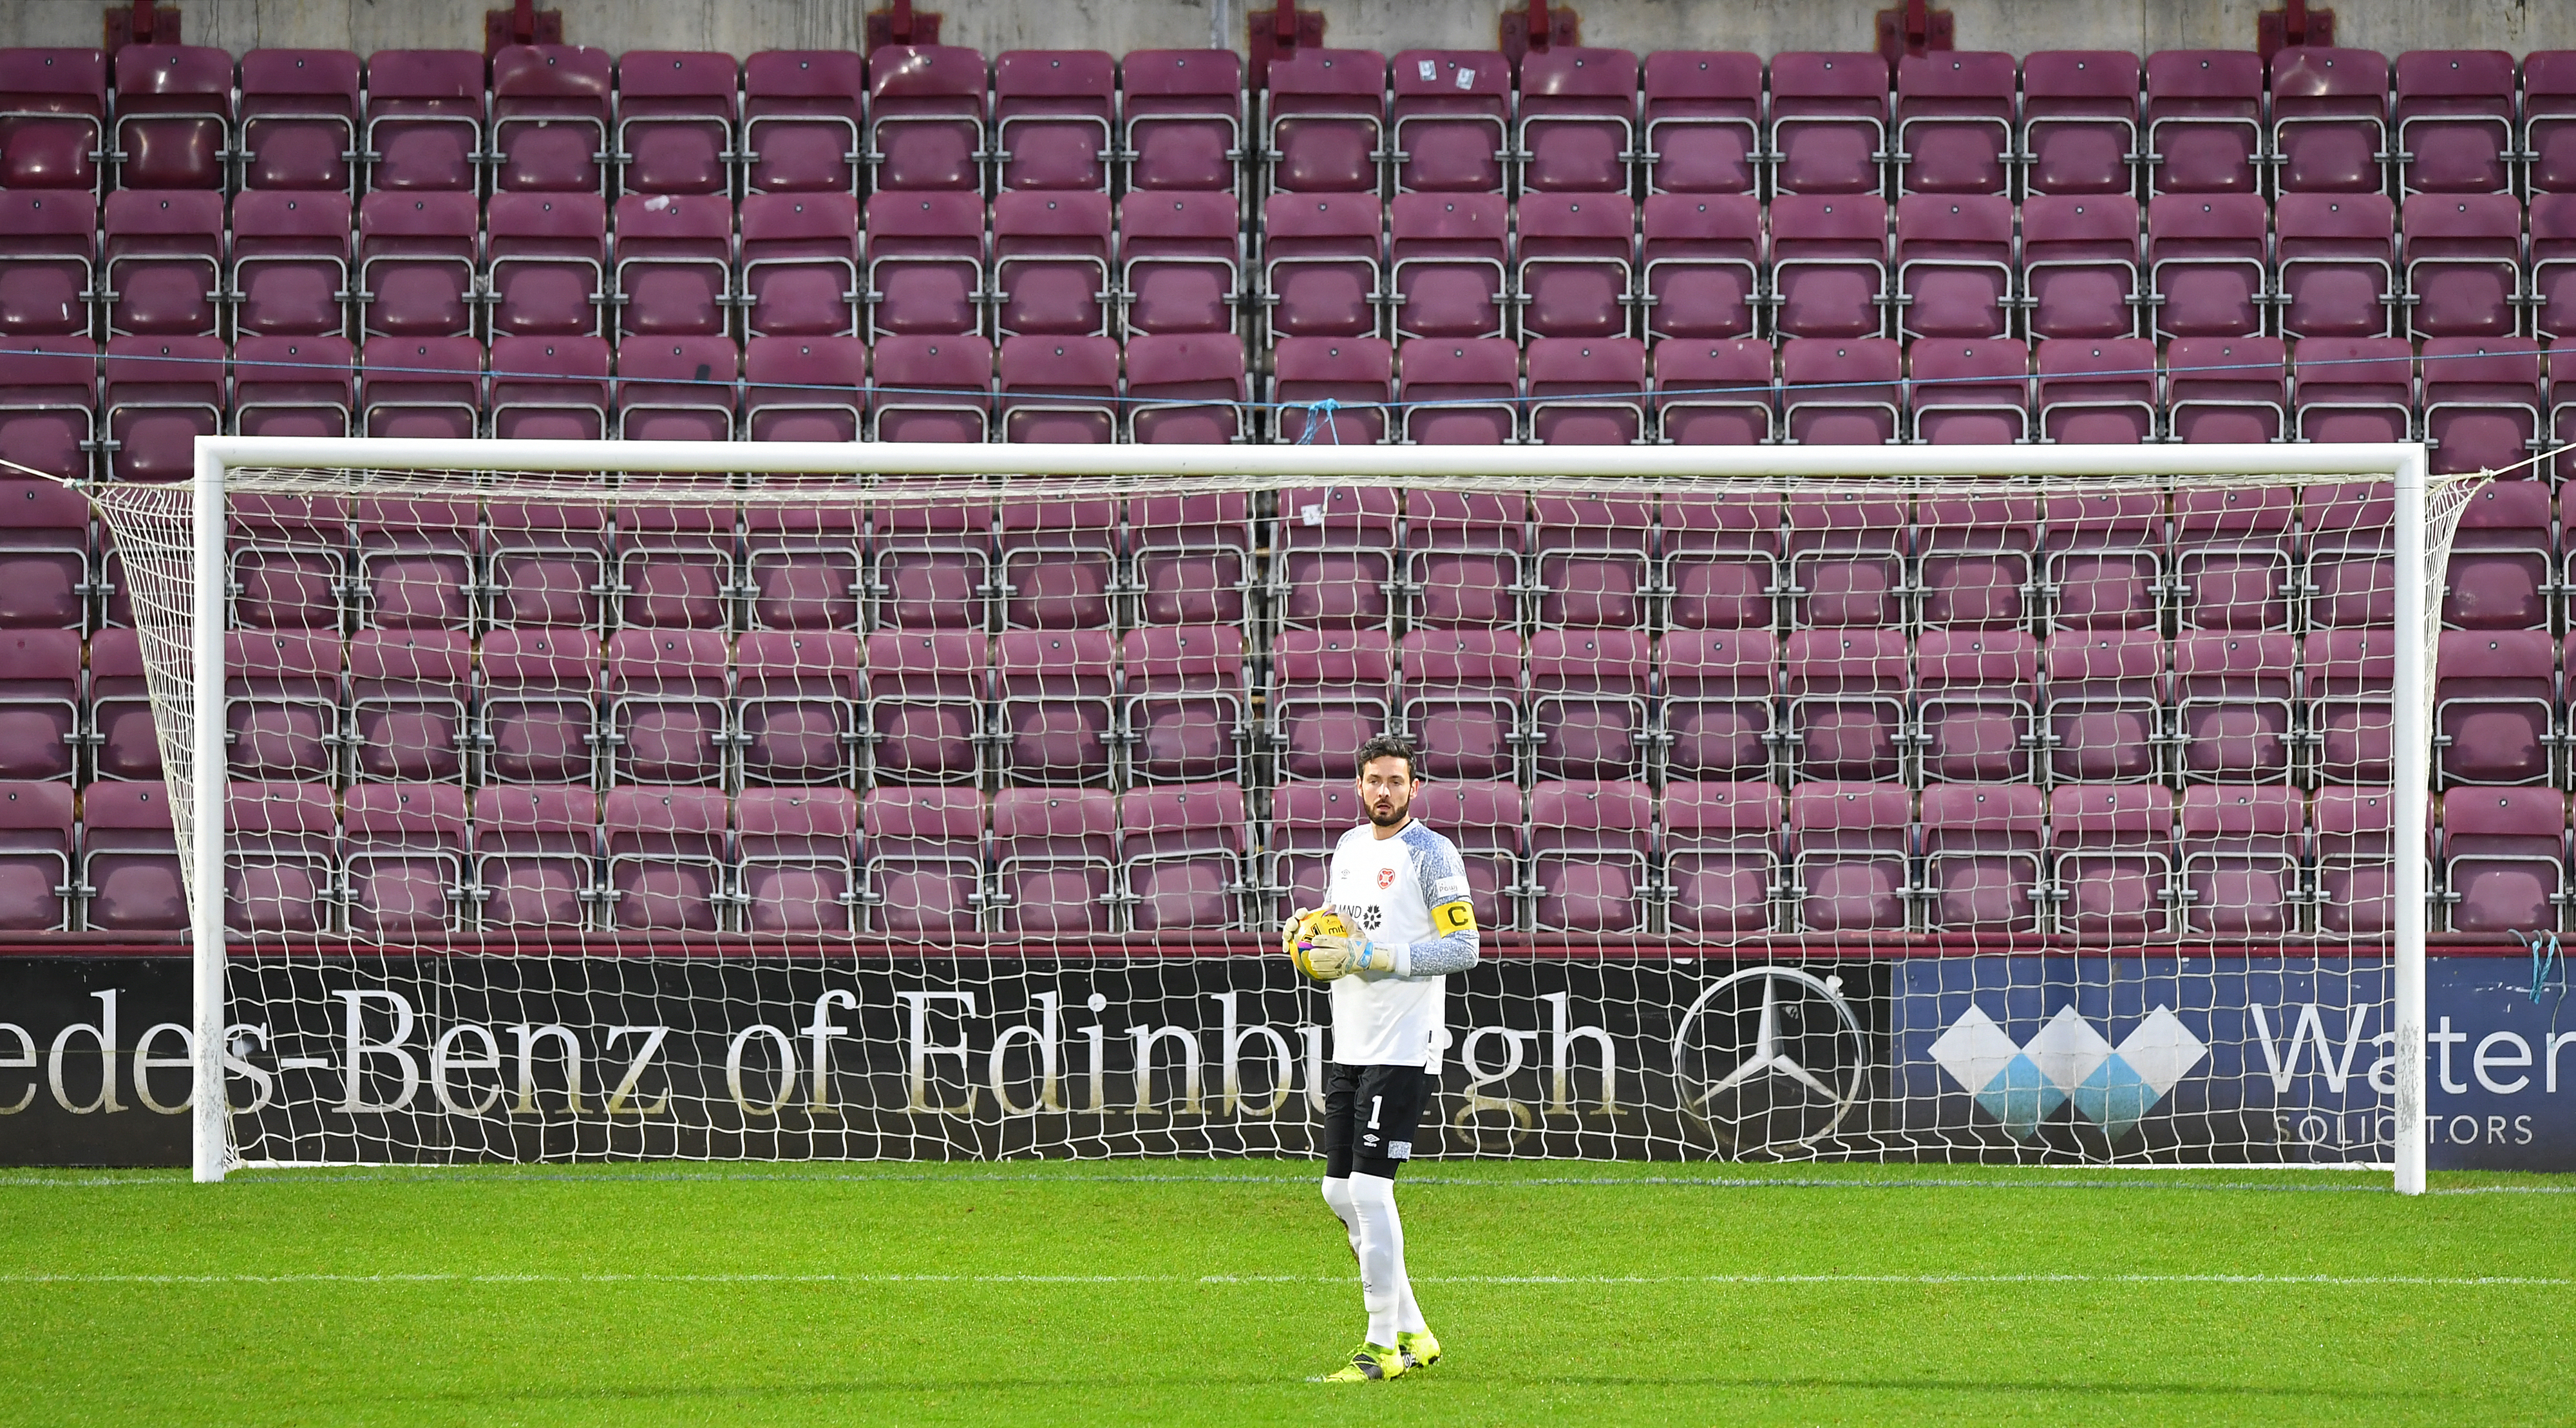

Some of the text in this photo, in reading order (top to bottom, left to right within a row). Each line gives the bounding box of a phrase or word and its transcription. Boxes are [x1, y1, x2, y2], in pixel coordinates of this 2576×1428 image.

[1447, 906, 1468, 926] C
[726, 990, 857, 1116] of
[896, 990, 1628, 1149] Edinbgh
[1367, 1094, 1383, 1130] 1
[2272, 1114, 2533, 1145] SOLICTORS
